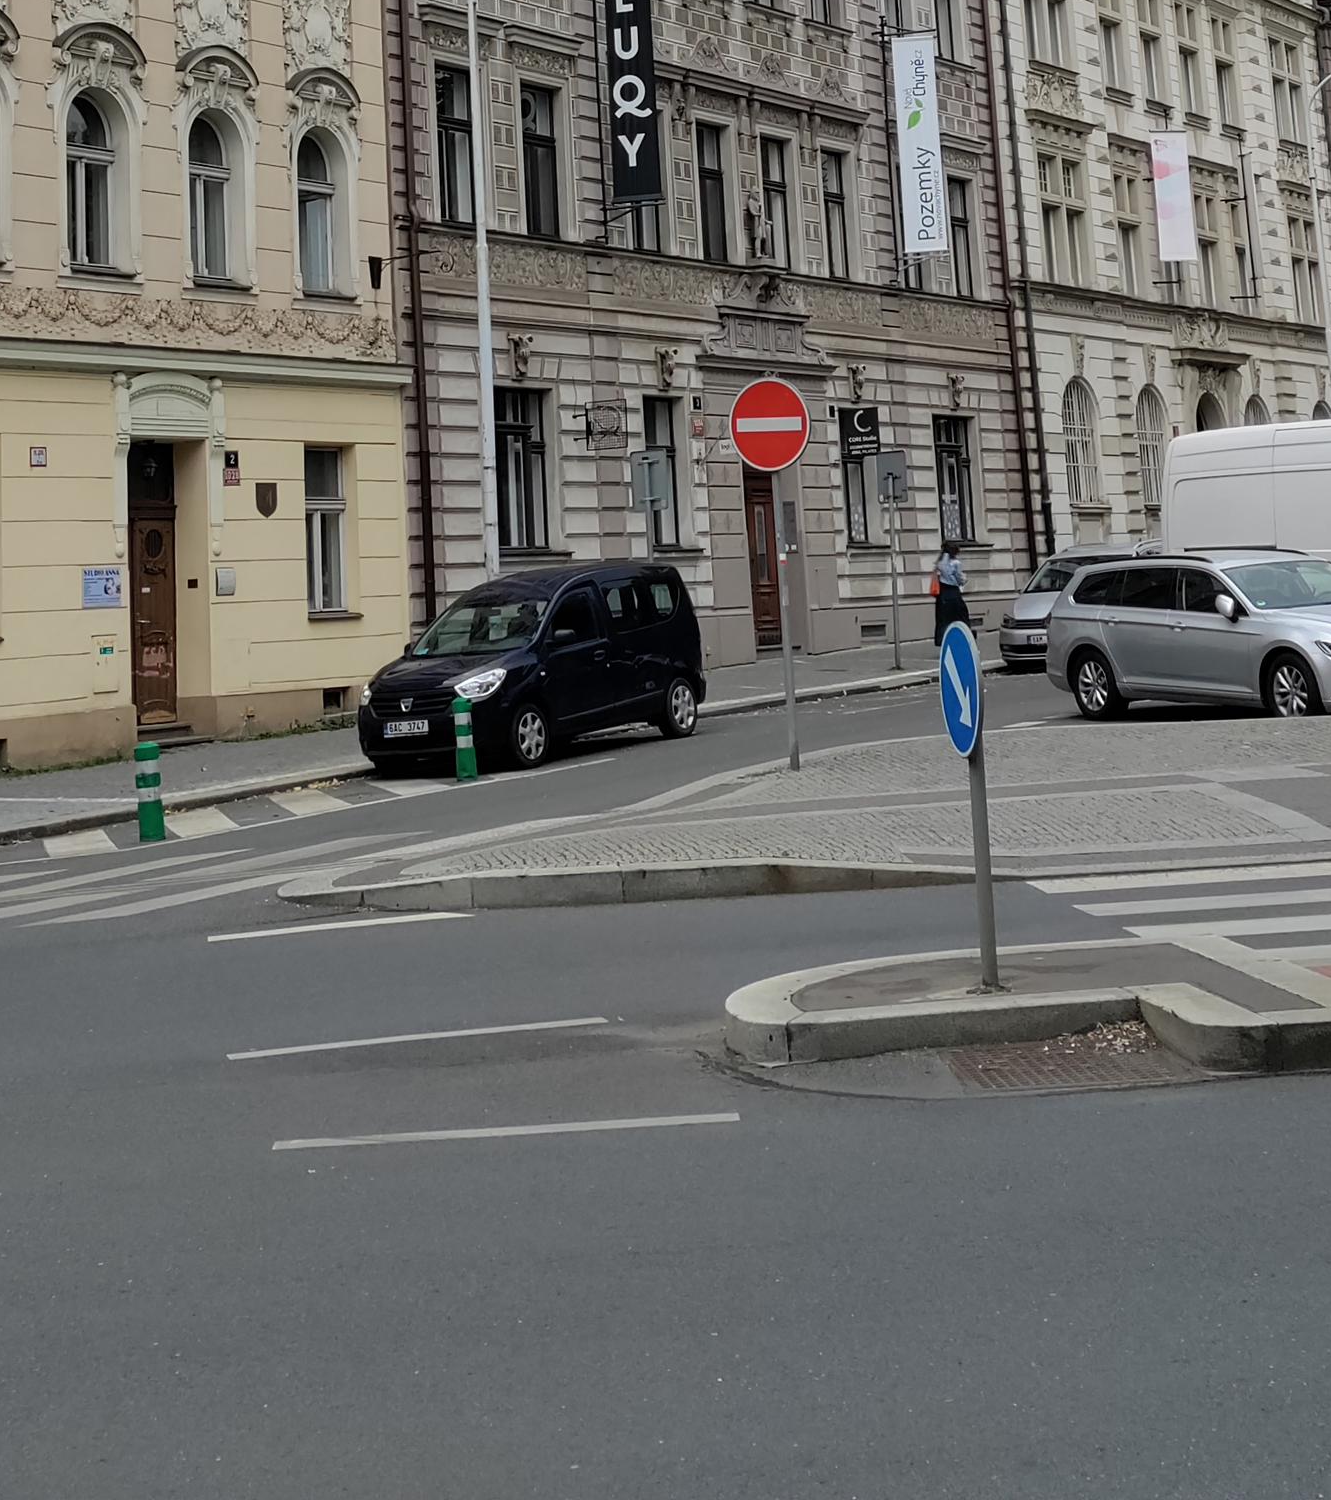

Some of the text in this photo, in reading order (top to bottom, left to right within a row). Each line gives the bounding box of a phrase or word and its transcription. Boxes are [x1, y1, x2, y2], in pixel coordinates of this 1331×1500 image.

[912, 147, 936, 240] Pozemky
[229, 454, 236, 464] 2
[389, 721, 426, 733] 6AC 3747
